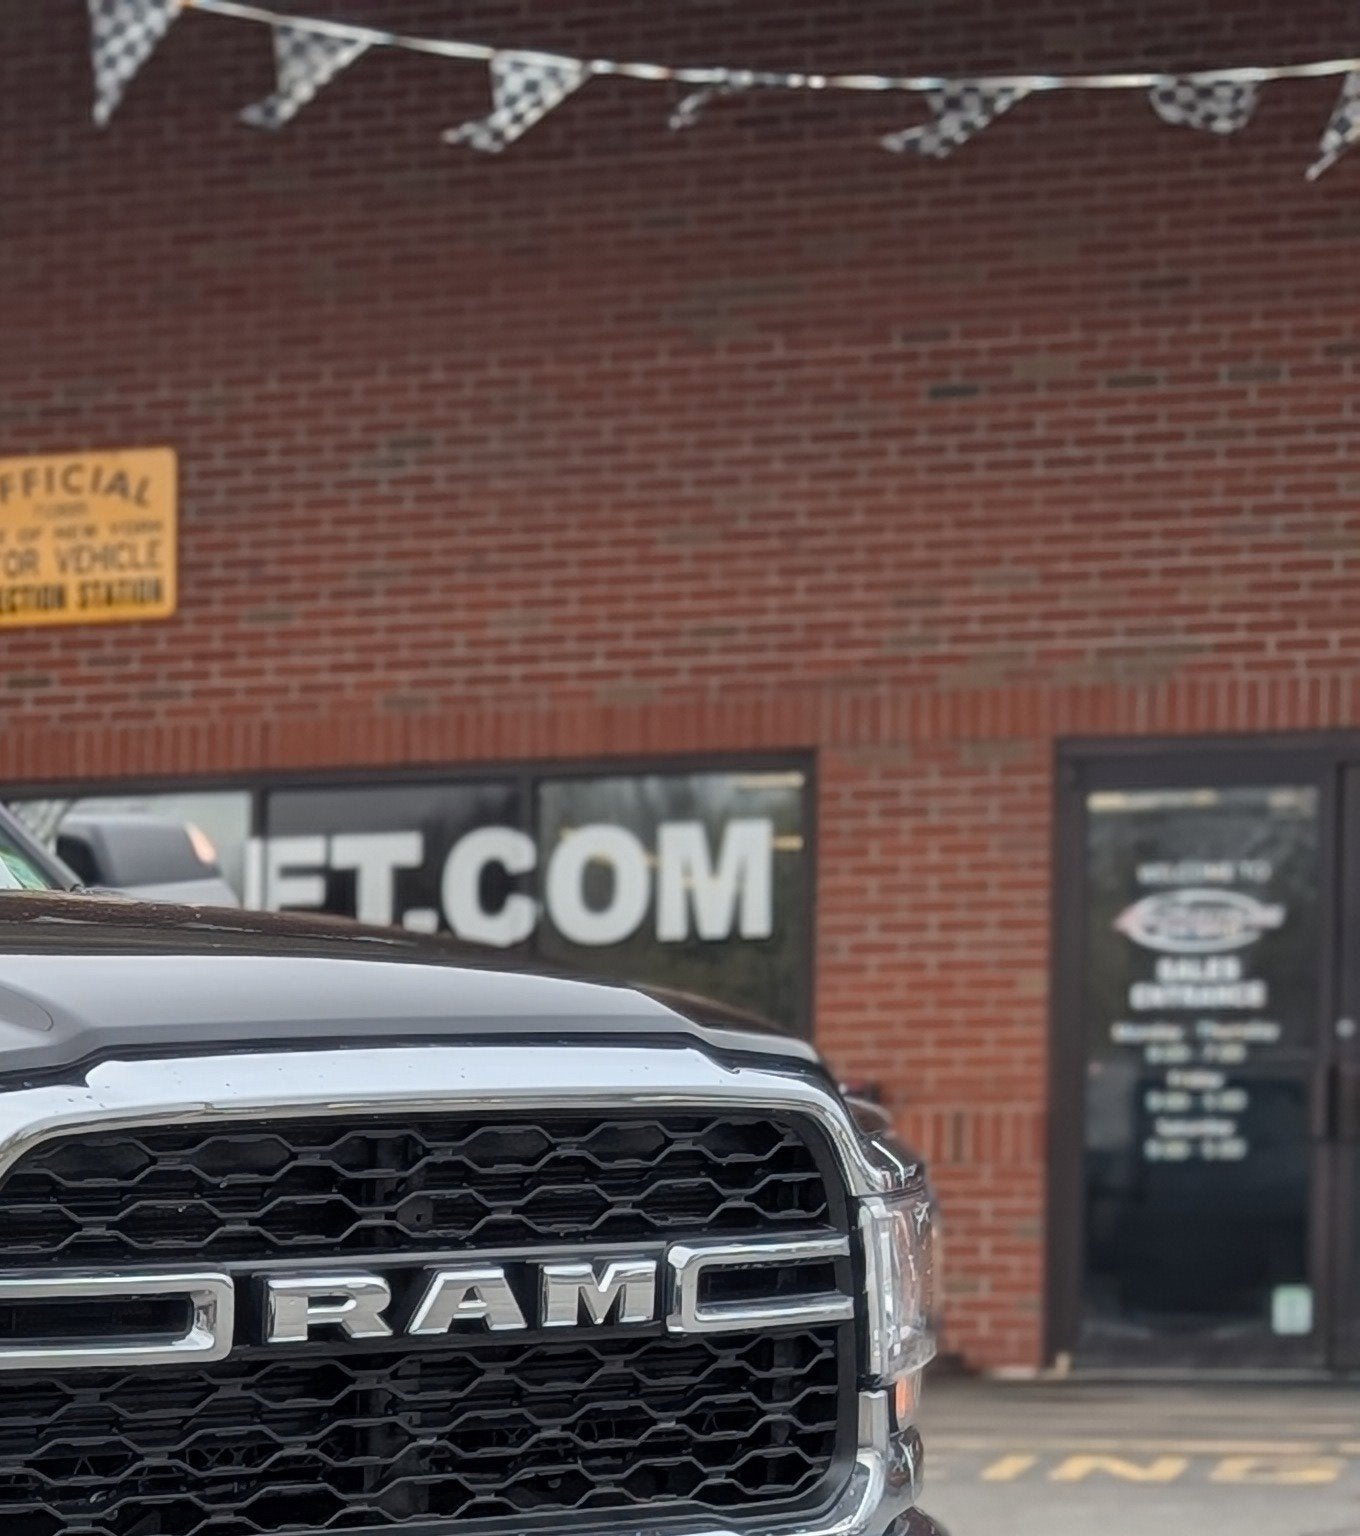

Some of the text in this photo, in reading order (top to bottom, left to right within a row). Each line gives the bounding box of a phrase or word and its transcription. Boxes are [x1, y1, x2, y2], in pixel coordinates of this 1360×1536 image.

[53, 538, 164, 574] VEHICLE
[78, 575, 164, 609] STATION
[266, 1259, 658, 1343] RAM
